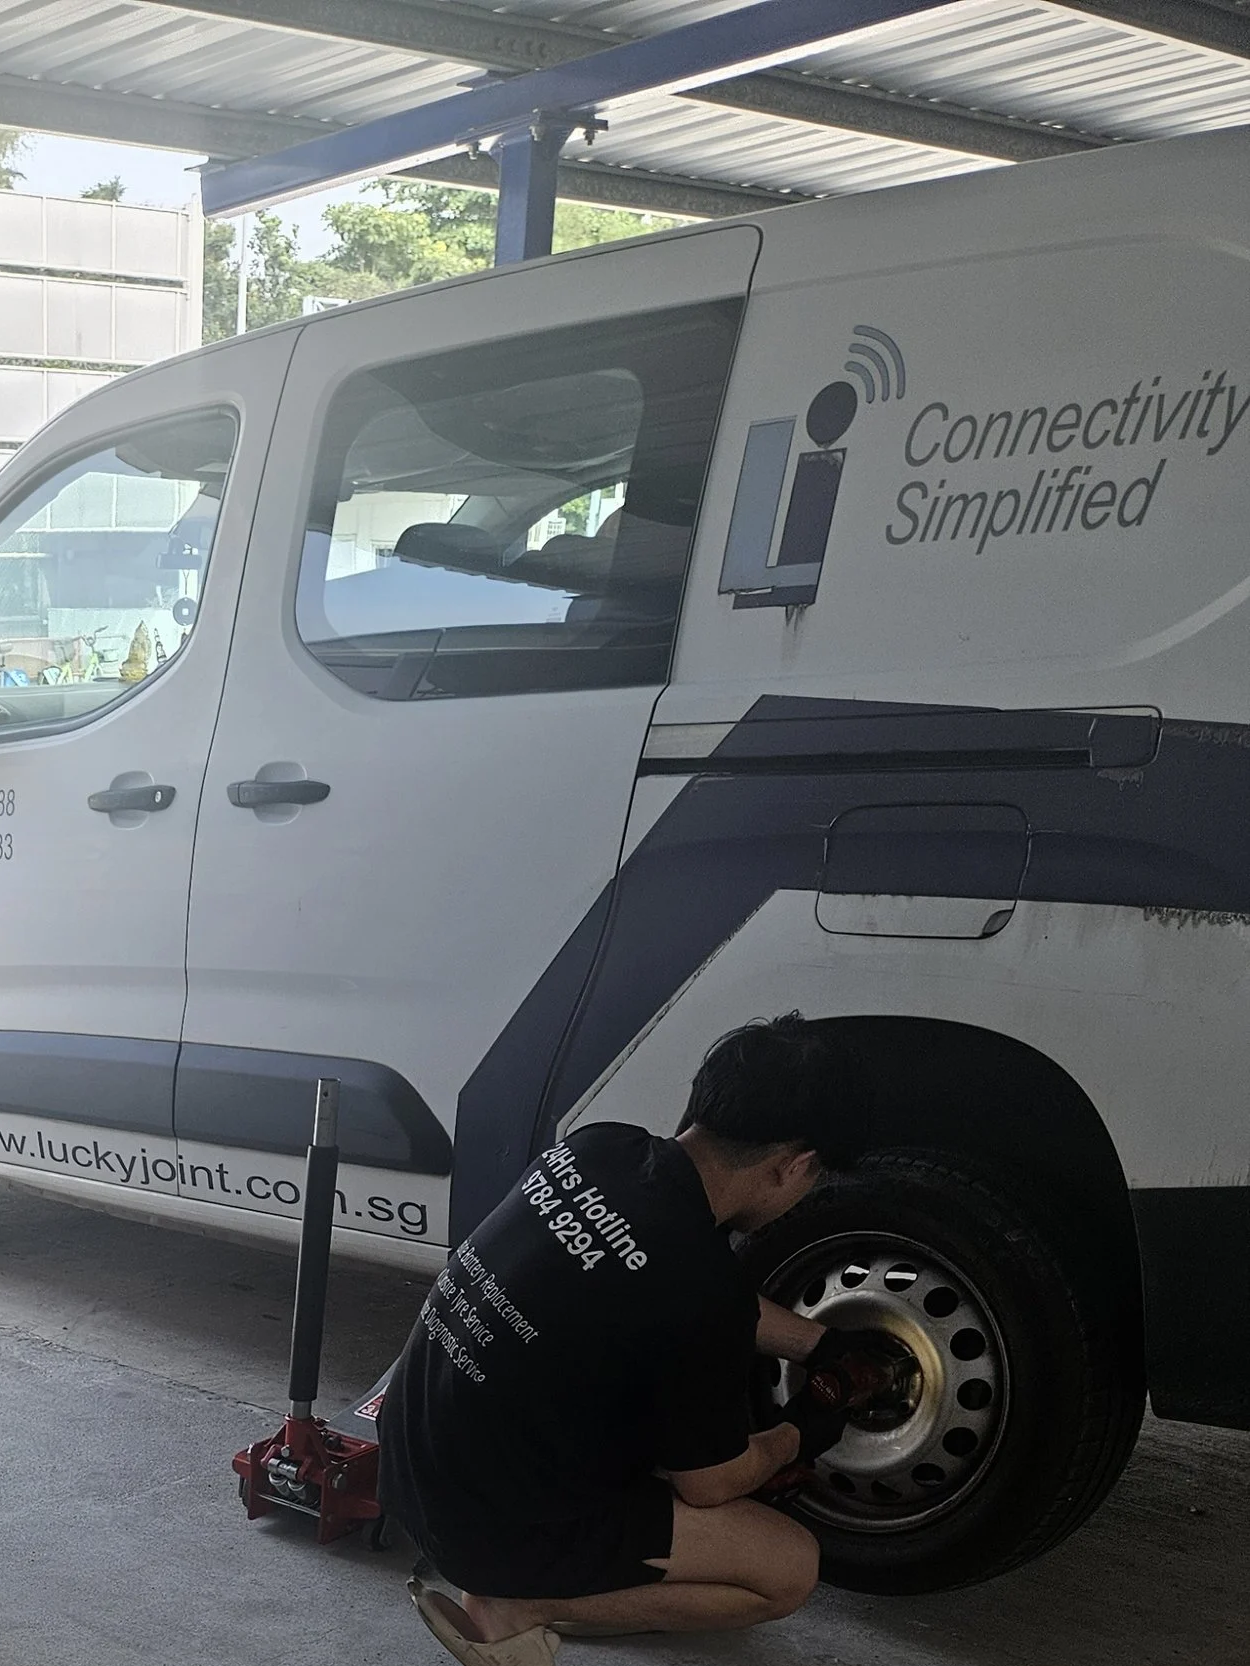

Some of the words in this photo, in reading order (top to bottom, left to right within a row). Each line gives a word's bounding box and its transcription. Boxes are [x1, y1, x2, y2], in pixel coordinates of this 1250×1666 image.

[904, 369, 1250, 468] Connectivity
[885, 458, 1167, 556] Simplified
[521, 1169, 563, 1217] 9784
[548, 1211, 606, 1271] 9294
[572, 1186, 648, 1271] Hotline
[450, 1287, 470, 1317] Tyre
[463, 1306, 494, 1347] Service
[460, 1246, 488, 1286] Battery
[479, 1273, 540, 1344] Replacement
[424, 1307, 459, 1358] Diagnostic
[453, 1346, 486, 1382] Service
